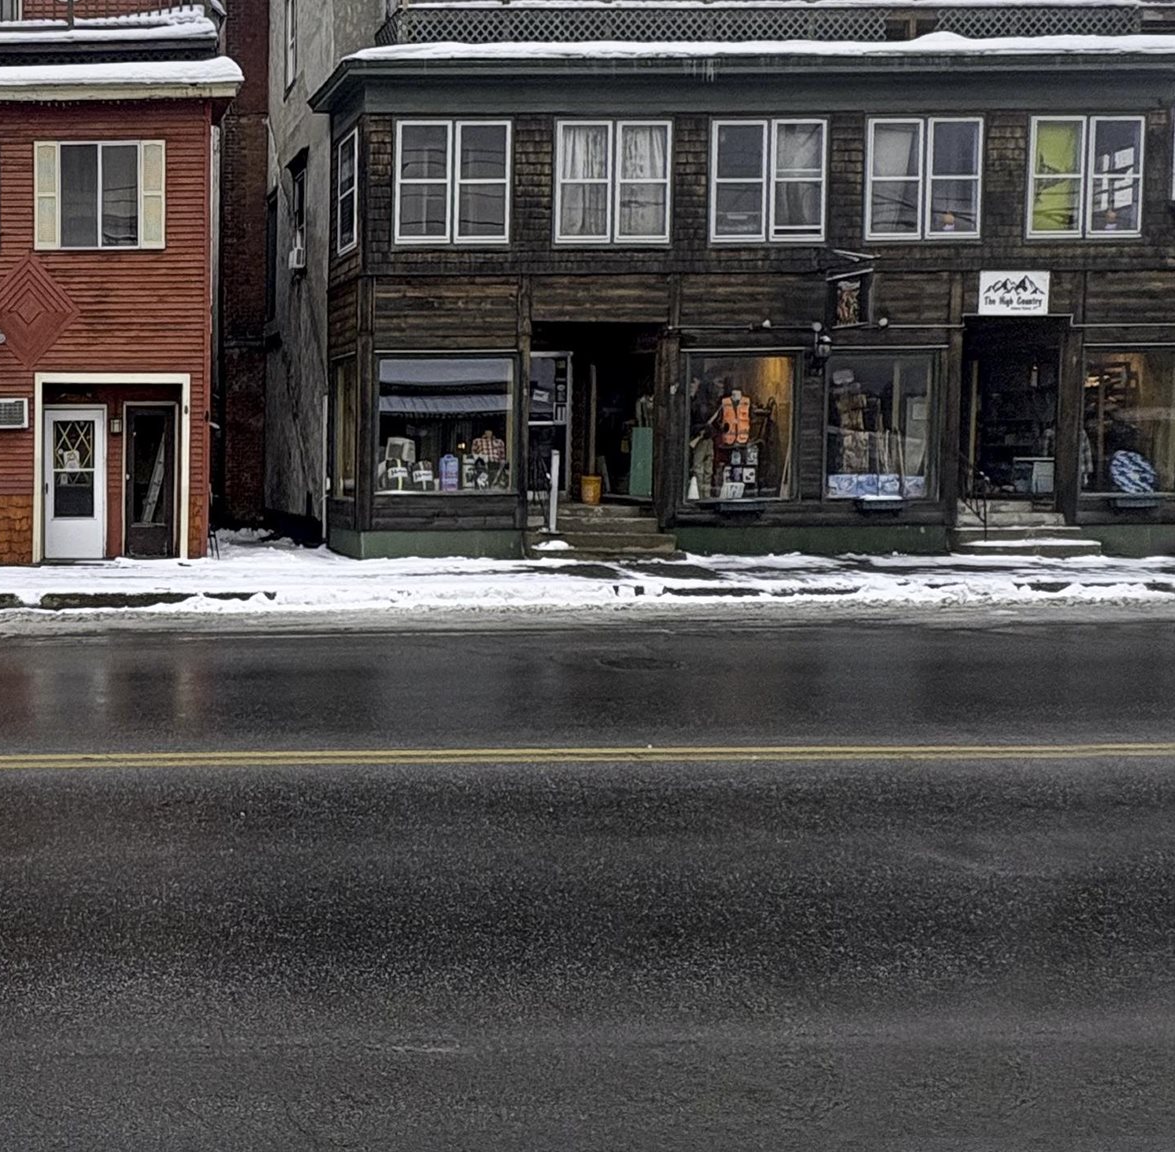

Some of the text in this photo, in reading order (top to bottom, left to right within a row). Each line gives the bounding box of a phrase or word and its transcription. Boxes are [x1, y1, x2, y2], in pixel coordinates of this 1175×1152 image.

[984, 296, 1042, 307] The High Country
